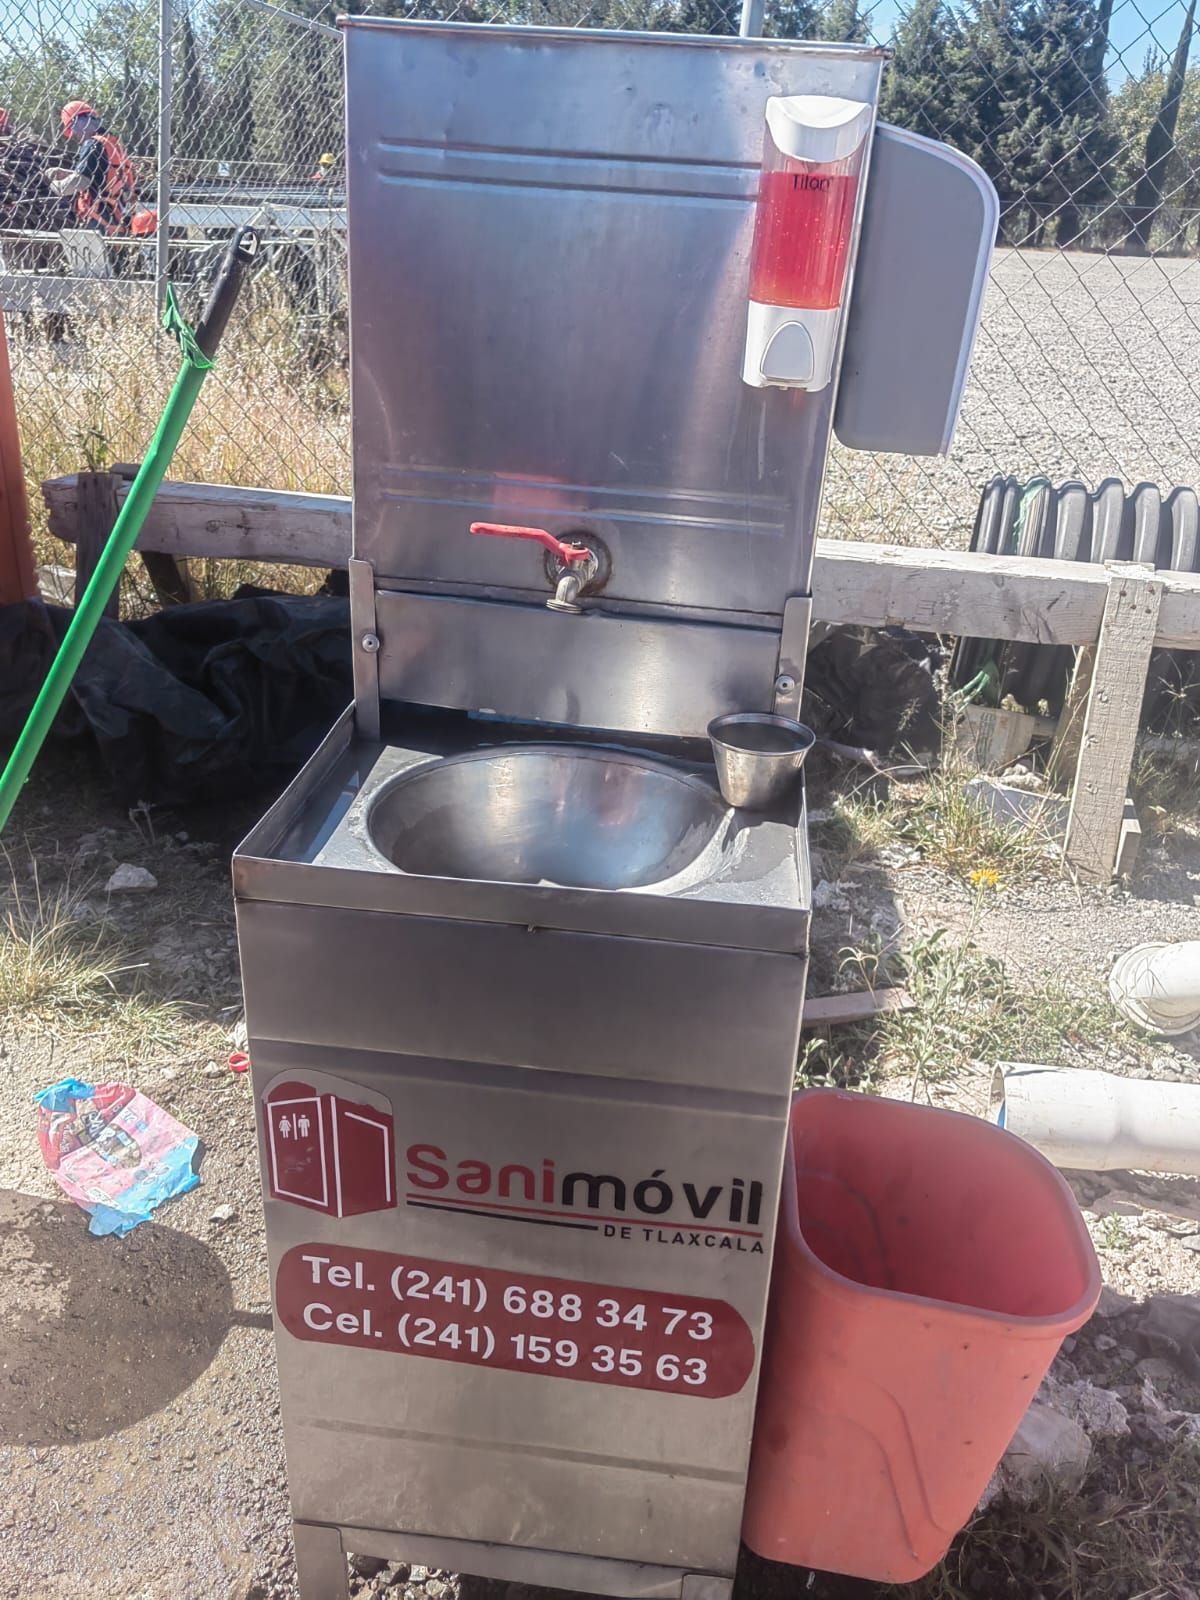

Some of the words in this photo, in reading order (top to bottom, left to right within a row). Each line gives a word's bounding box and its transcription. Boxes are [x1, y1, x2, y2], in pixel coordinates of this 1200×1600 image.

[406, 1143, 764, 1226] Sanimóvil
[604, 1224, 631, 1240] DE
[642, 1228, 764, 1255] TLAXCALA
[302, 1255, 375, 1292] Tel.
[390, 1265, 488, 1313] (241)
[503, 1285, 582, 1322] 688
[596, 1298, 648, 1331] 34
[661, 1307, 714, 1341] 73
[303, 1302, 383, 1338] Cel.
[397, 1312, 496, 1360] (241)
[509, 1333, 579, 1368] 159
[591, 1344, 642, 1377] 35
[655, 1353, 708, 1385] 63
